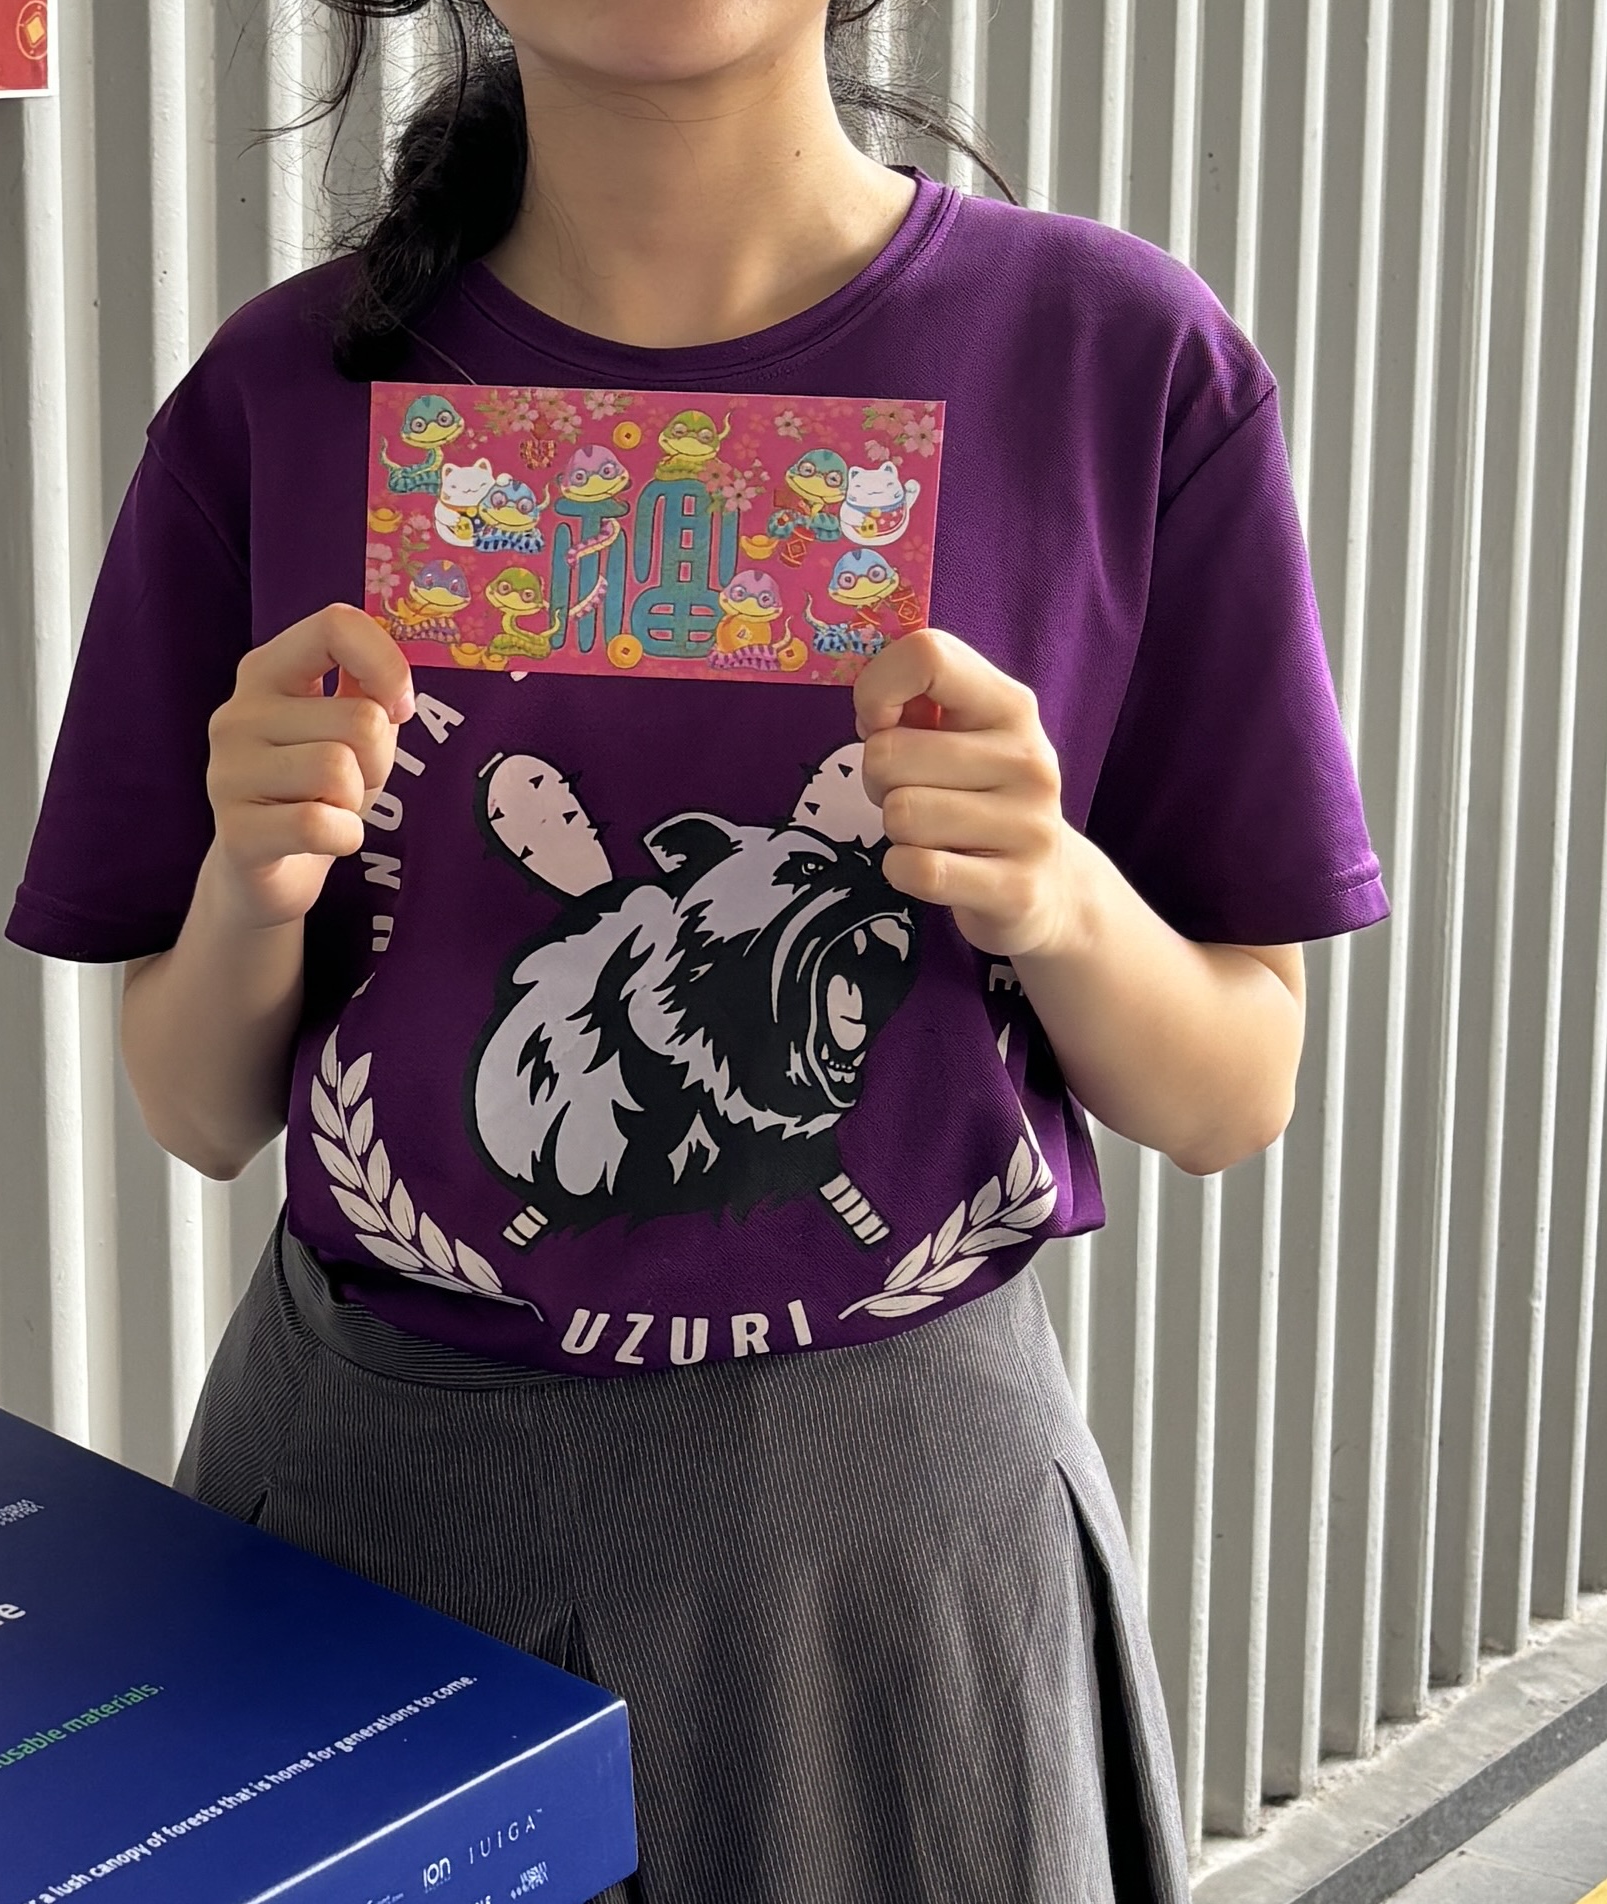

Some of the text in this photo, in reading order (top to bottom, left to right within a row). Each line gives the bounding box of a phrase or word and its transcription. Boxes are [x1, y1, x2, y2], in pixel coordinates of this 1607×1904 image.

[561, 1298, 813, 1367] UZURI
[62, 1682, 165, 1734] materials.
[54, 1874, 93, 1897] lush
[88, 1844, 151, 1881] canopy
[146, 1829, 167, 1849] of
[162, 1804, 223, 1839] forests
[217, 1785, 258, 1813] that
[252, 1777, 272, 1795] is
[265, 1755, 315, 1791] home
[309, 1745, 337, 1767] for
[333, 1699, 421, 1753] generations
[416, 1691, 436, 1709] to
[431, 1675, 478, 1702] come.
